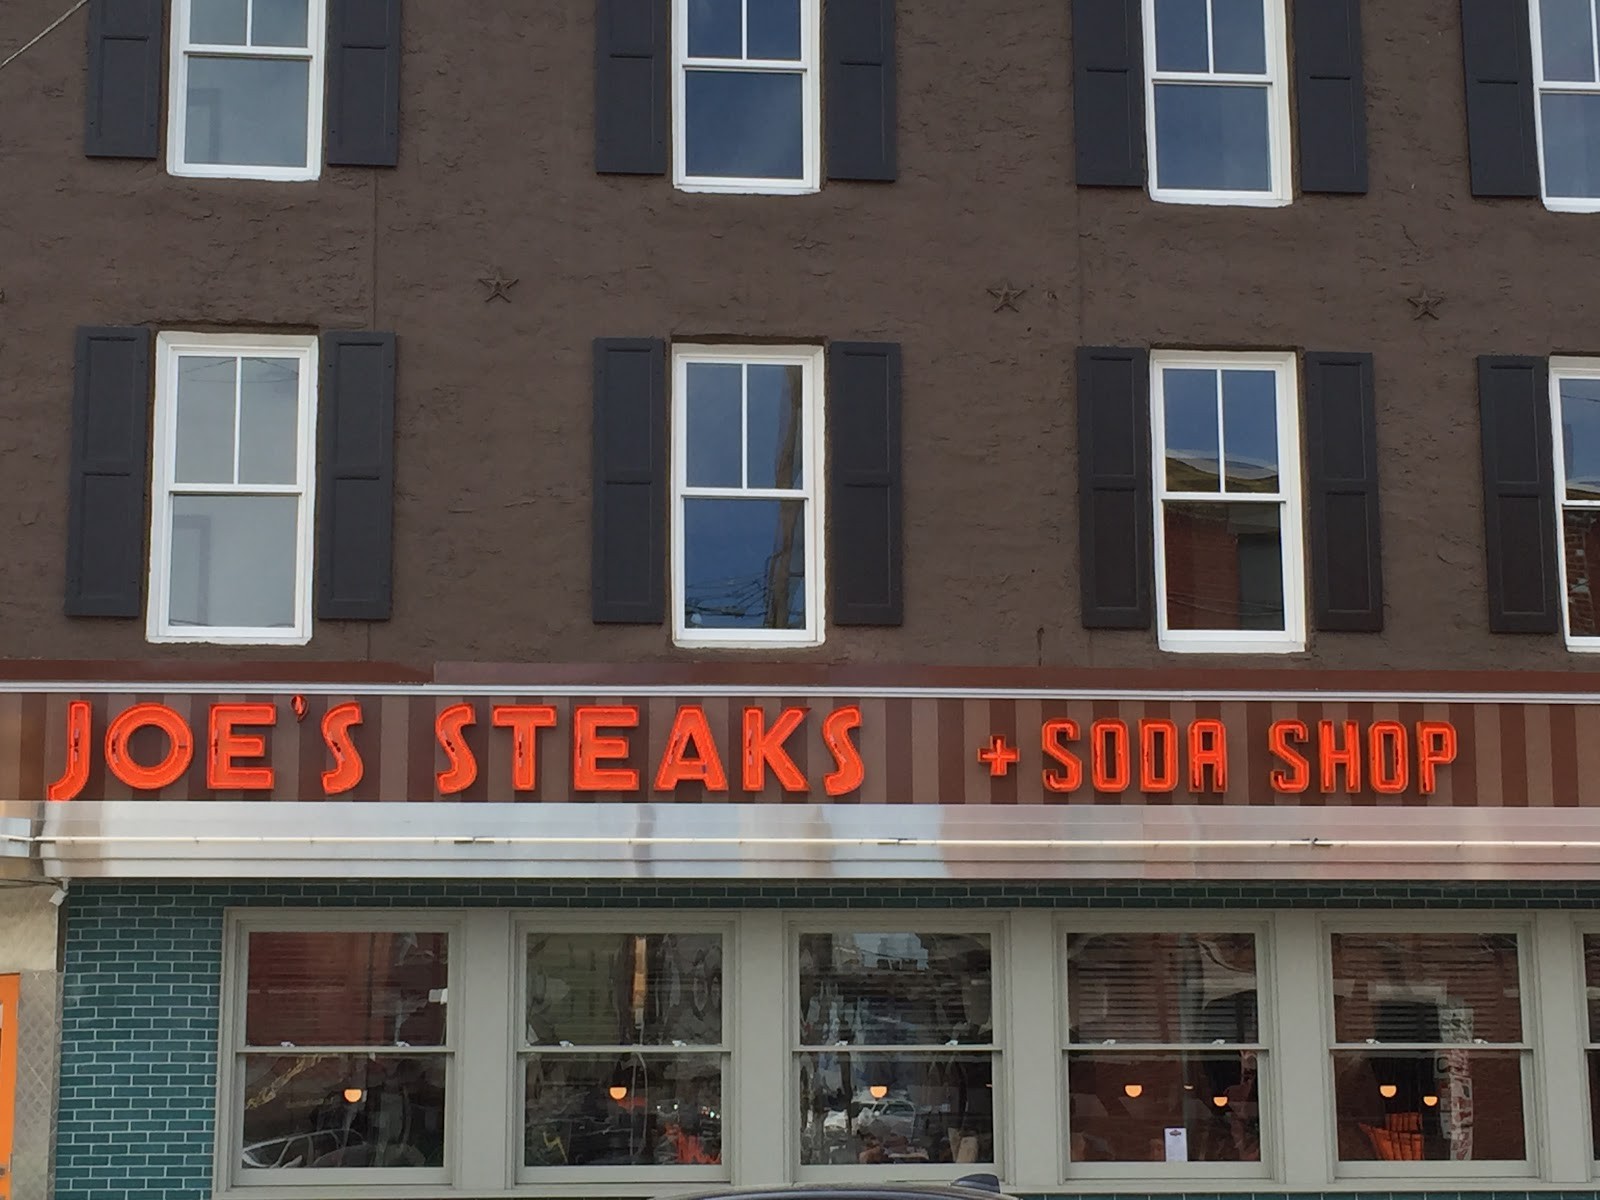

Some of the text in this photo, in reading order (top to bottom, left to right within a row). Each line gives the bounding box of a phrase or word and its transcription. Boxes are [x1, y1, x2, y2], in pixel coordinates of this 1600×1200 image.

[47, 695, 1458, 801] JOE'S STEAKS + SODA SHOP
